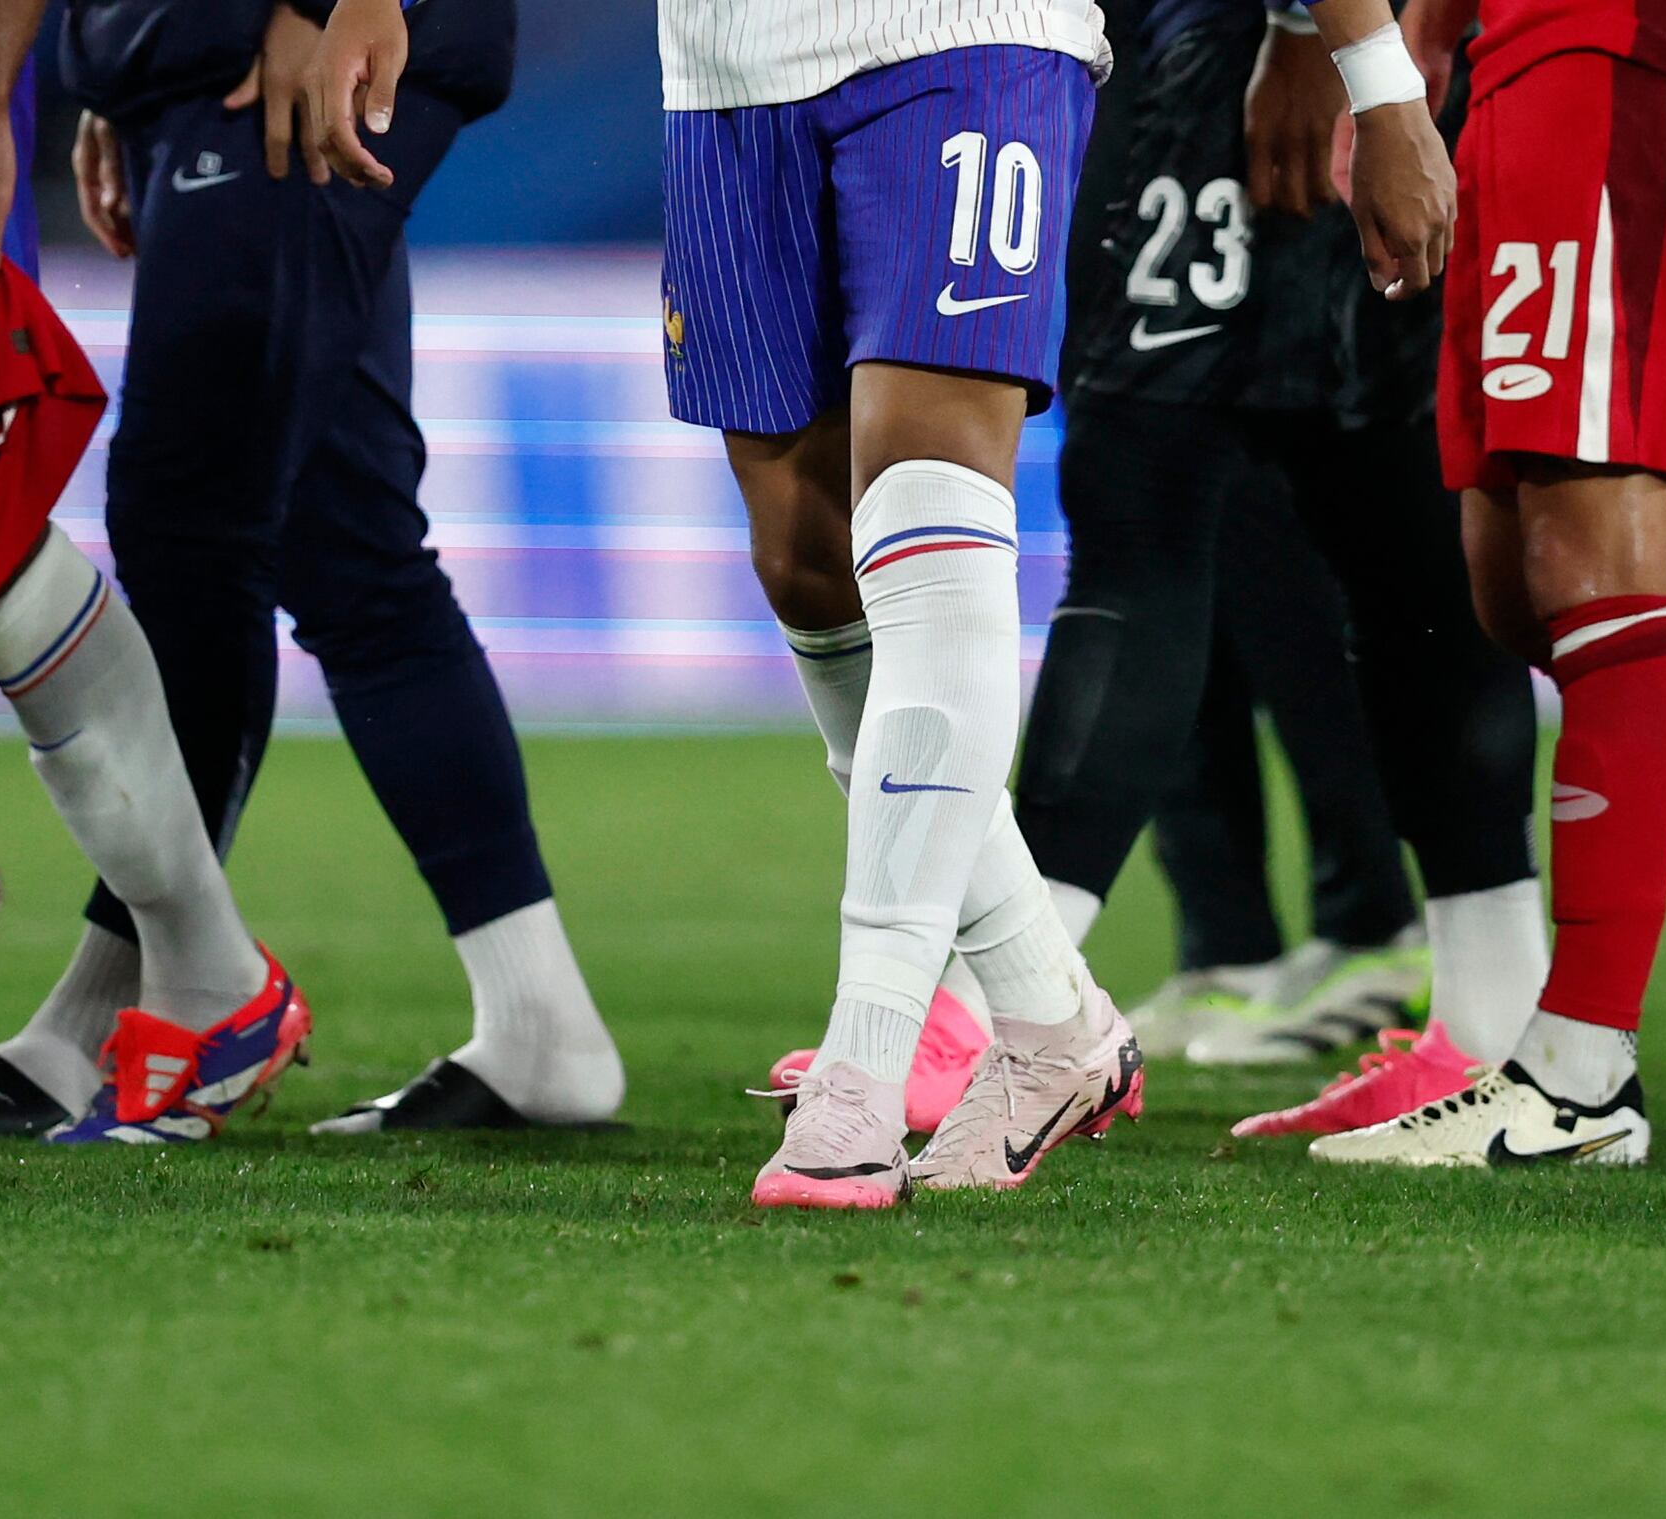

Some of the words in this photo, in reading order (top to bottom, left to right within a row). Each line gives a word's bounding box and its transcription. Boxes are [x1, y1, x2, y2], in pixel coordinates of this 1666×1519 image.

[941, 131, 1042, 276] 10
[1126, 175, 1253, 310] 23
[1481, 240, 1580, 360] 21
